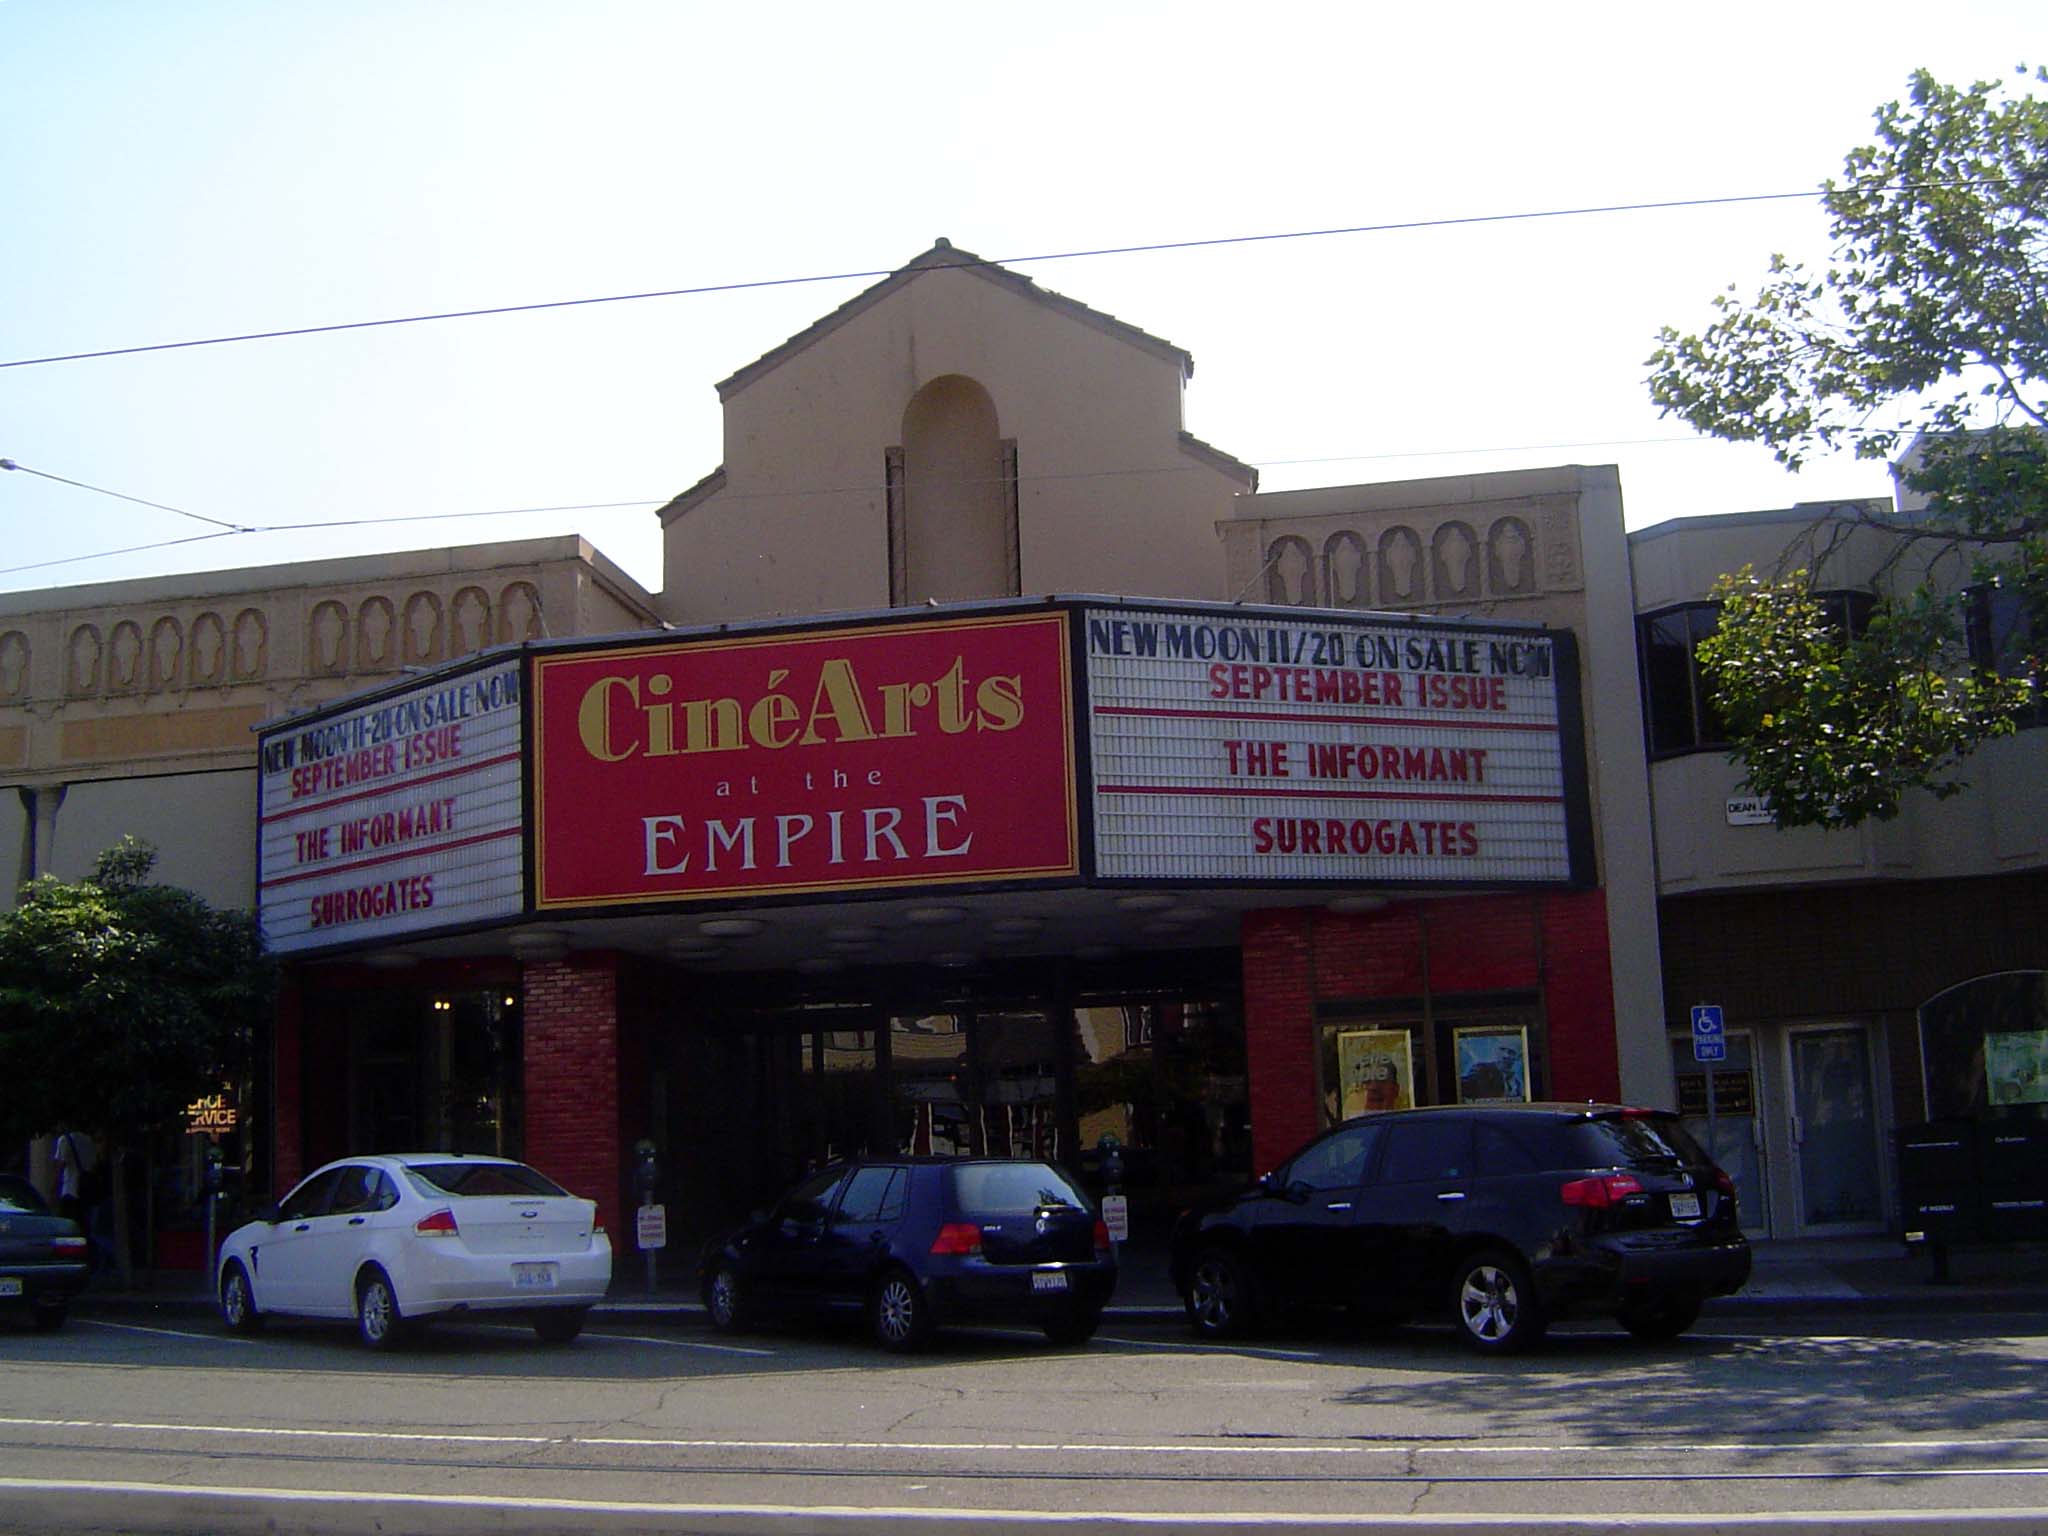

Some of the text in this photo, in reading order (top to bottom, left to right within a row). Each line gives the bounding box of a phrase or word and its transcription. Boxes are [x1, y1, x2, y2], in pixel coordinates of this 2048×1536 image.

[1088, 619, 1157, 661] NEW
[1166, 624, 1259, 662] MOON
[1357, 635, 1400, 669] ON
[1405, 637, 1480, 674] SALE
[577, 655, 1026, 763] CinéArts
[1209, 663, 1508, 711] SEPTEMBER ISSUE
[263, 736, 294, 773] NEW
[300, 727, 348, 761] MOON
[393, 703, 421, 738] ON
[423, 686, 471, 726] SALE
[475, 671, 519, 714] NOW
[291, 724, 462, 798] SEPTEMBER ISSUE
[715, 768, 883, 796] at the
[1224, 741, 1487, 782] THE INFORMANT
[296, 798, 458, 862] THE INFORMANT
[1729, 800, 1756, 814] DEAN
[642, 794, 973, 876] EMPIRE
[1252, 818, 1479, 856] SURROGATES
[311, 875, 433, 928] SURROGATES
